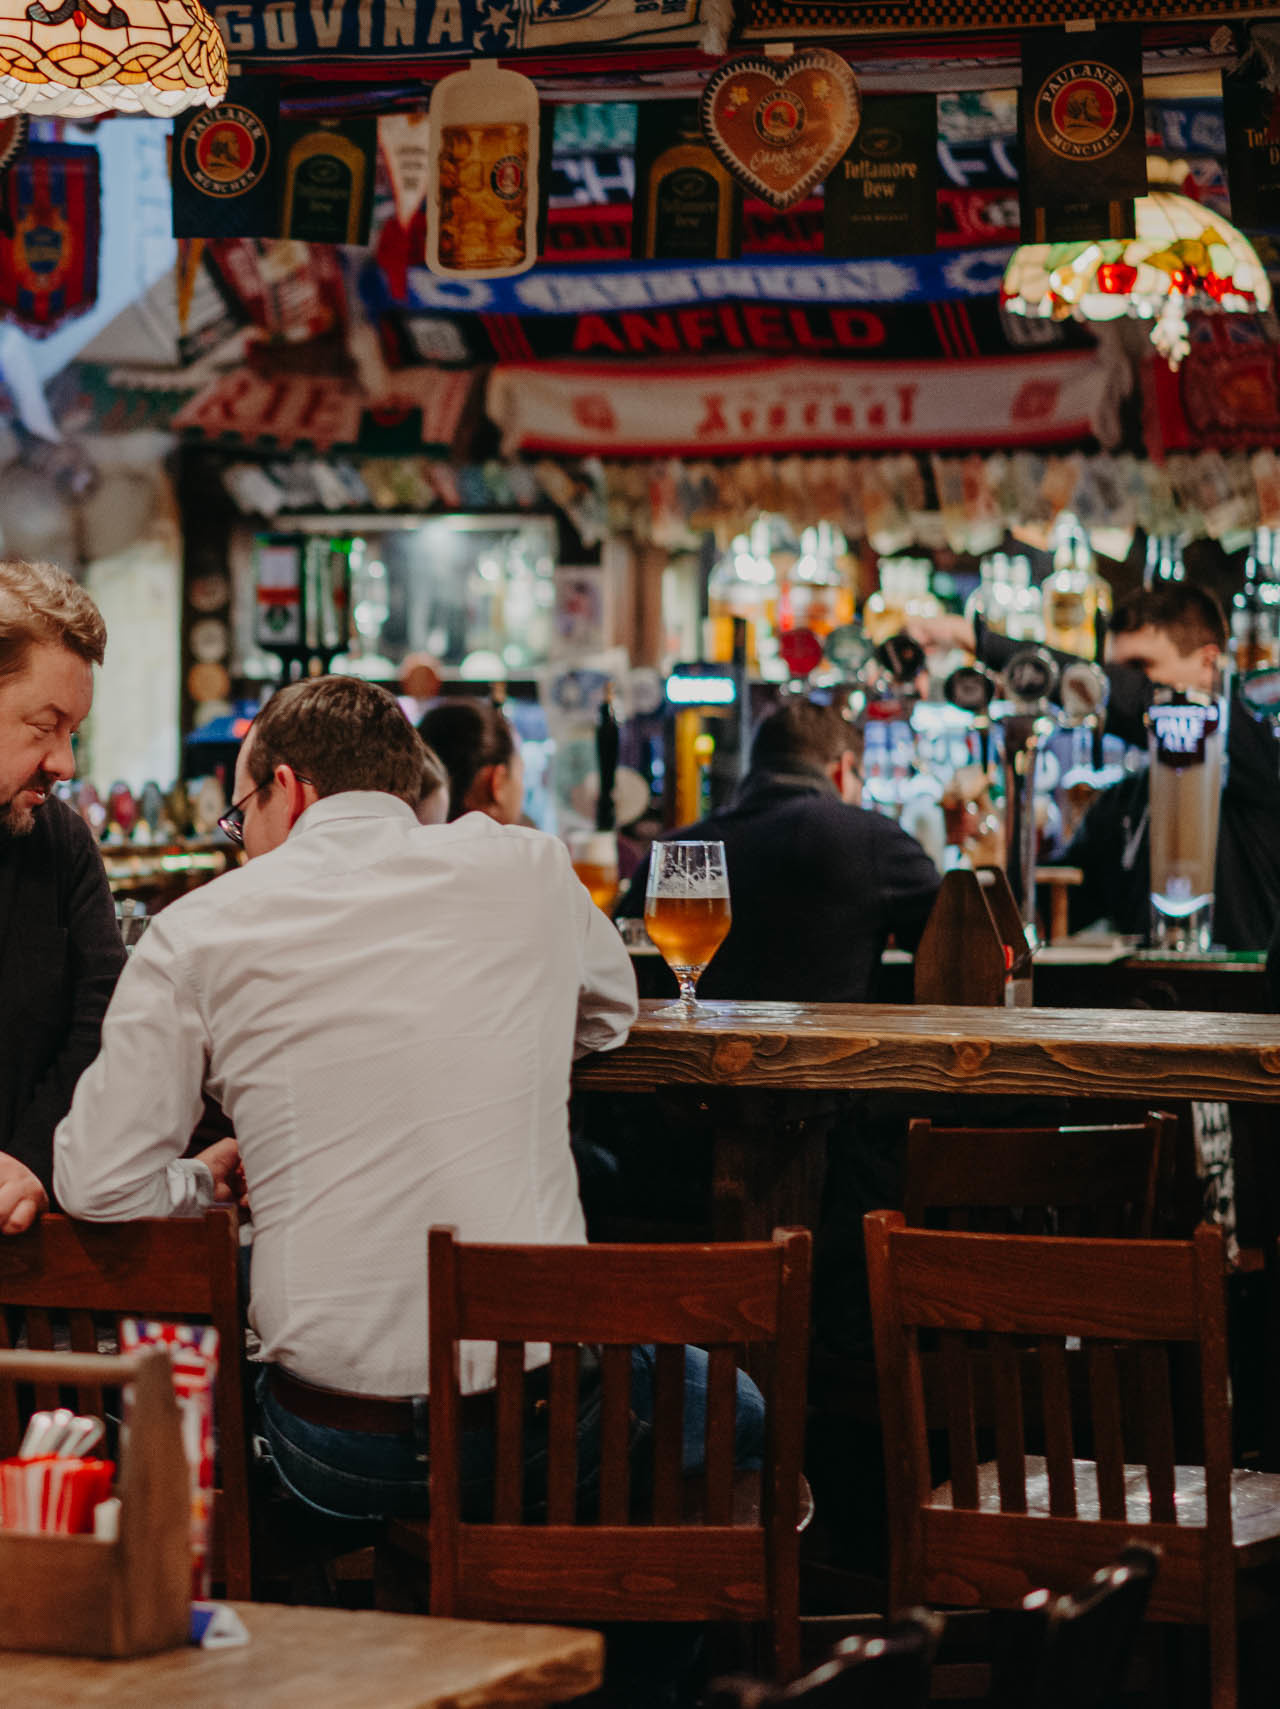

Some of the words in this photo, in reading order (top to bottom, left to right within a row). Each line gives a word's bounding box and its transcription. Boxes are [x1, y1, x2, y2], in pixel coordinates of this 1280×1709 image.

[1041, 65, 1125, 102] PAULANER
[187, 106, 263, 141] PAULANER
[843, 160, 917, 181] Tullamore
[862, 180, 896, 200] Dew
[573, 306, 888, 354] ANFIELD
